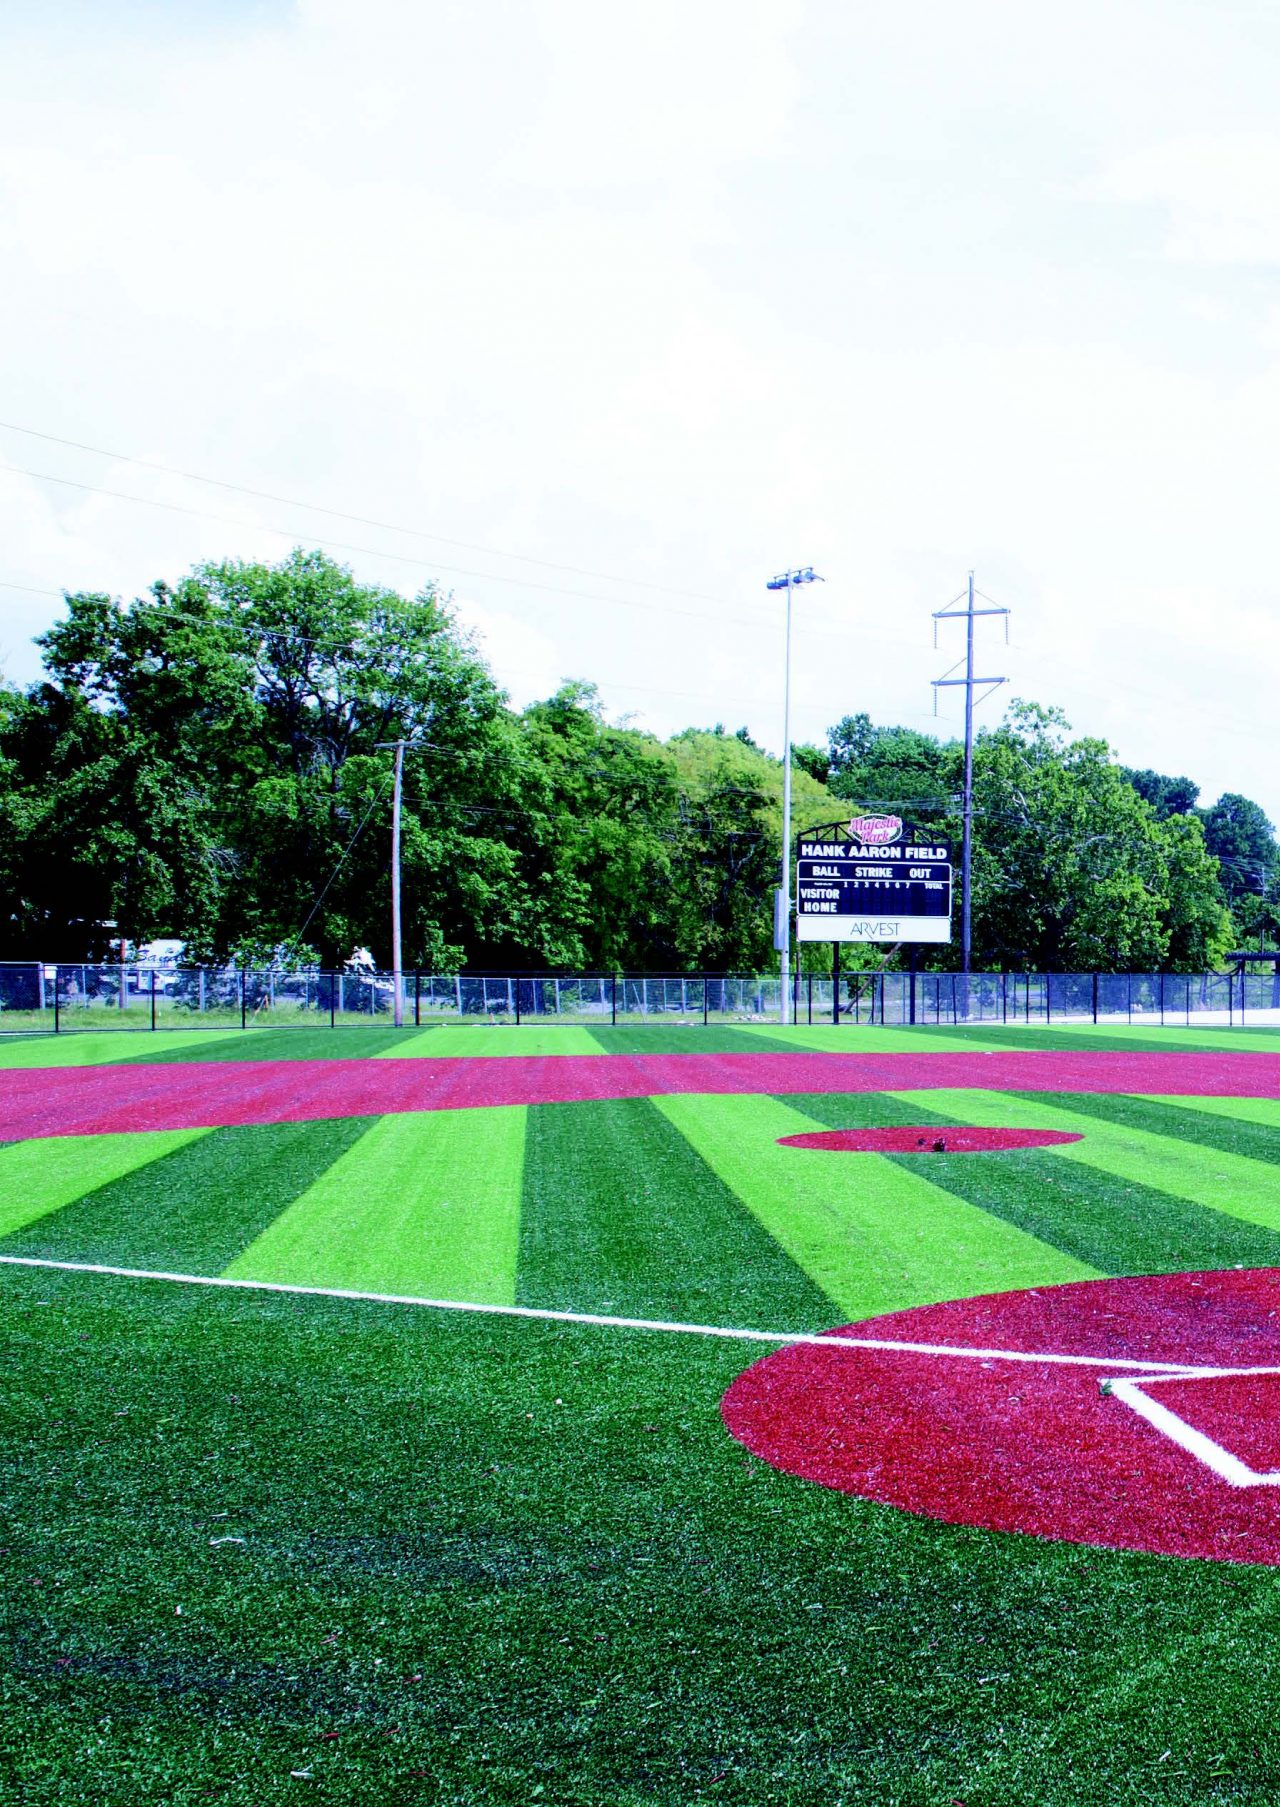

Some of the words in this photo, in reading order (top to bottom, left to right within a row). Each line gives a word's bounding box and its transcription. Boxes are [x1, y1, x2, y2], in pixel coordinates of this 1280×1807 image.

[849, 815, 901, 831] Majestic
[861, 830, 890, 845] Park
[801, 844, 846, 858] HANK
[848, 846, 901, 859] AARON
[905, 847, 948, 859] FIELD
[812, 866, 841, 877] BALL
[855, 867, 893, 878] STRIKE
[909, 868, 932, 879] OUT
[800, 888, 840, 899] VISITOR
[804, 902, 838, 912] HOME
[850, 922, 900, 939] ARVEST
